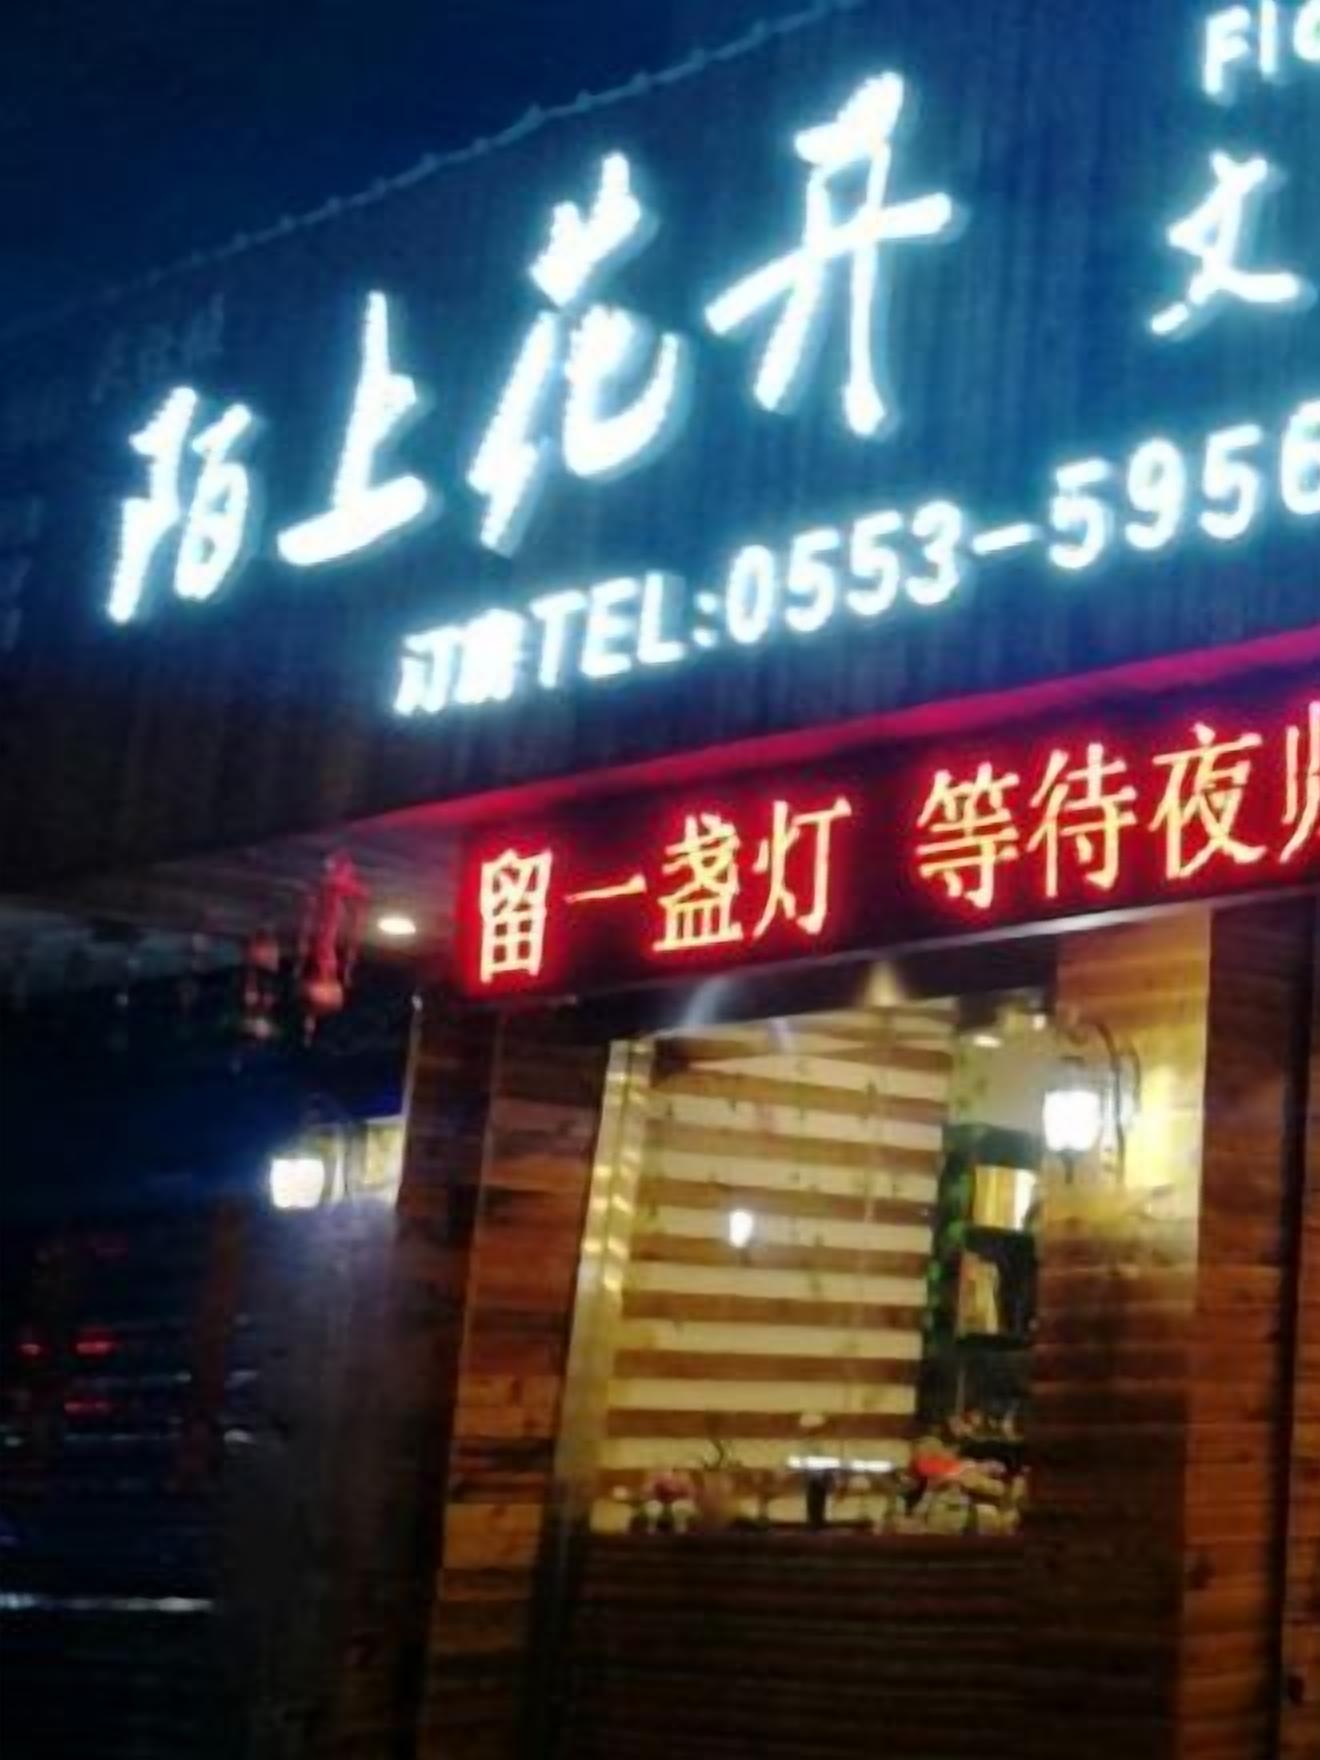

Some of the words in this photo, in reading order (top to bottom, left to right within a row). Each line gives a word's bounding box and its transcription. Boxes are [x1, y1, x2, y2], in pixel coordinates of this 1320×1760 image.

[105, 71, 955, 624] 陌上花开
[476, 796, 854, 984] 留一盏灯
